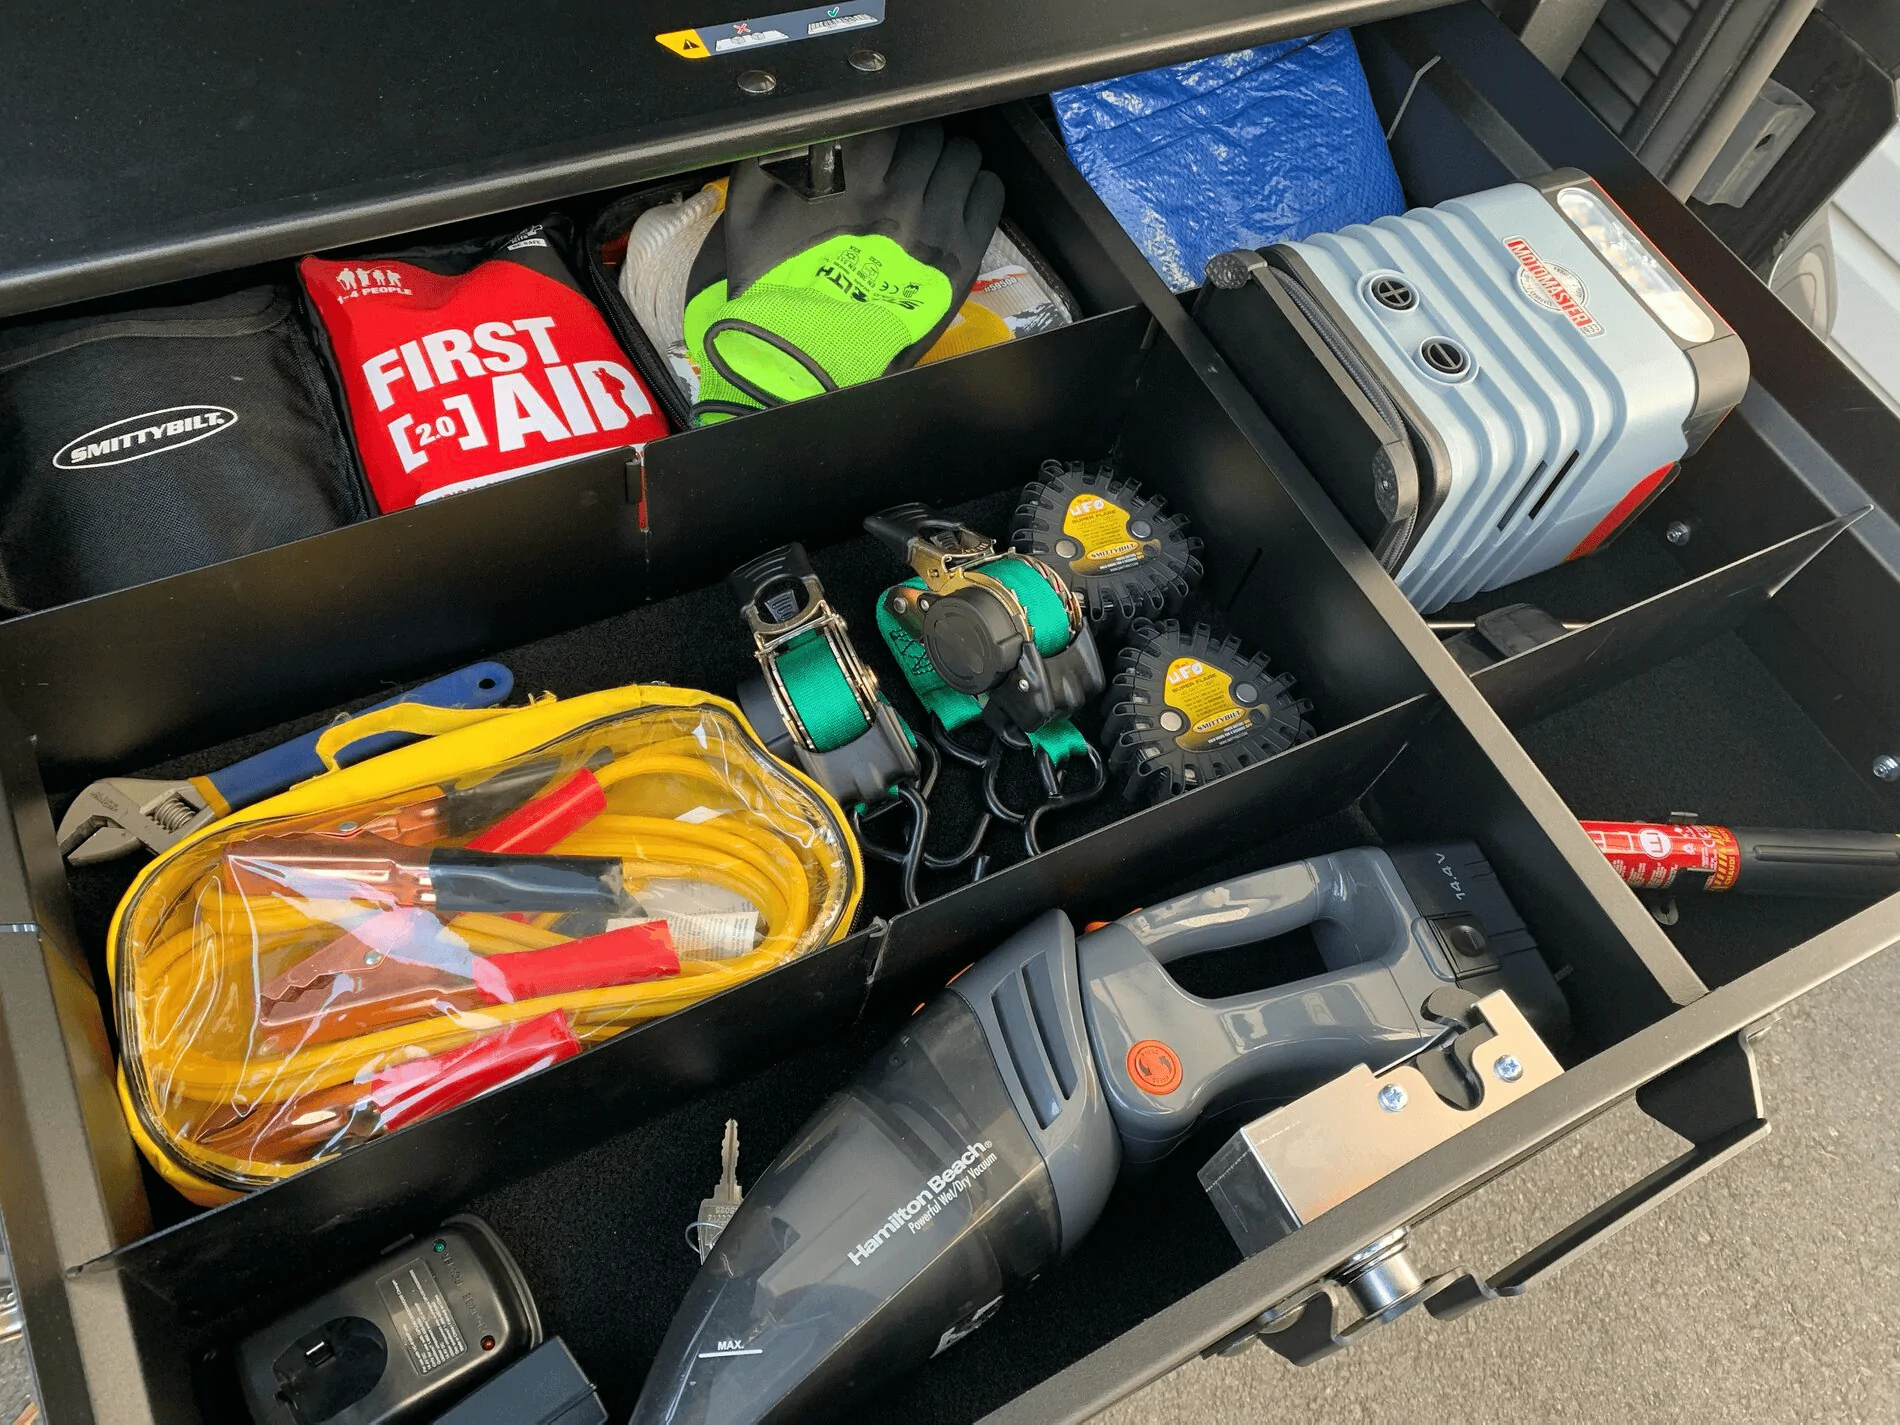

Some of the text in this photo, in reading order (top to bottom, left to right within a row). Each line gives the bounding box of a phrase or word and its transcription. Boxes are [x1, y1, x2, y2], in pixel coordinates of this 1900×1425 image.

[361, 285, 413, 296] PEOPLE
[1511, 243, 1588, 324] MOTOMASTER
[361, 316, 564, 413] FIRST
[491, 360, 654, 452] AID
[1435, 852, 1466, 901] 14.4 V
[846, 1190, 934, 1267] Hamilton
[908, 1152, 998, 1235] Powerful Wet/Dry Vacuum
[717, 1340, 745, 1351] MAX.
